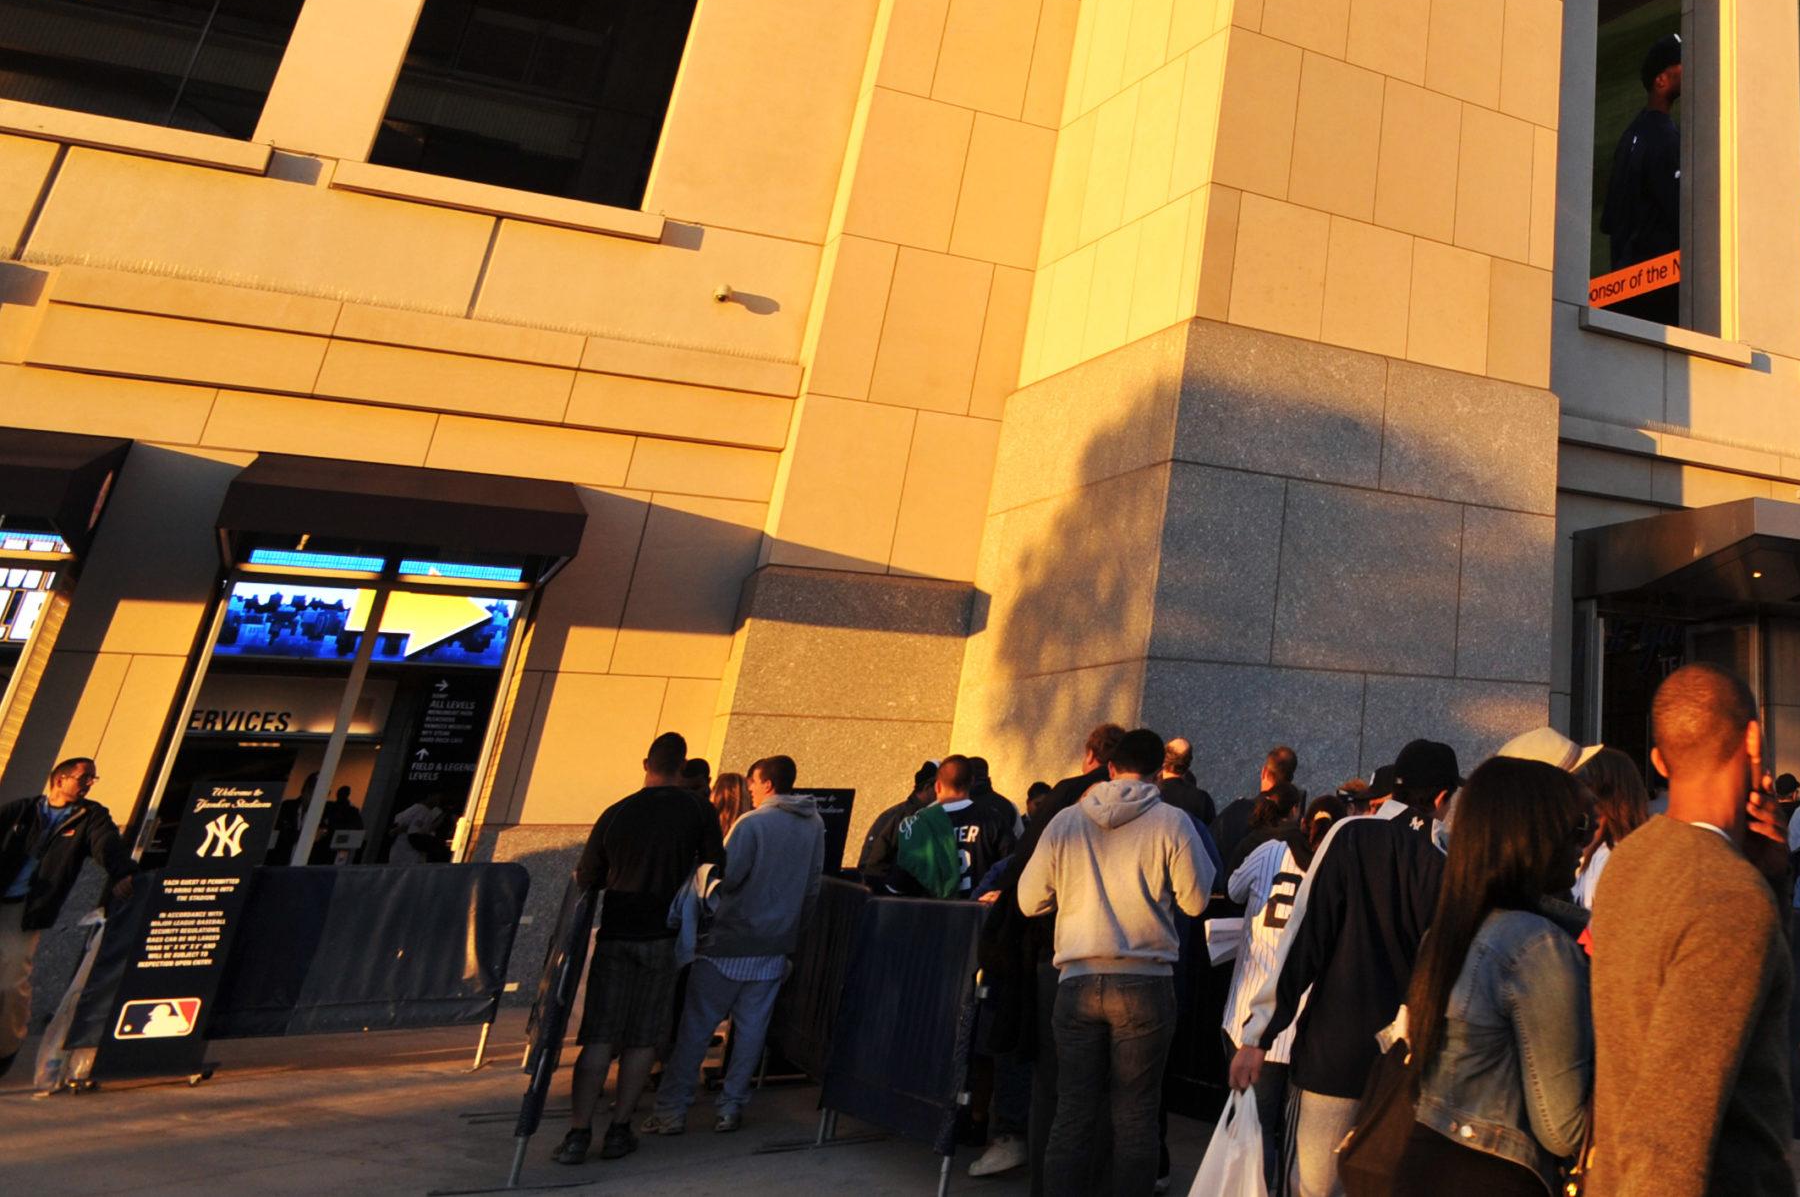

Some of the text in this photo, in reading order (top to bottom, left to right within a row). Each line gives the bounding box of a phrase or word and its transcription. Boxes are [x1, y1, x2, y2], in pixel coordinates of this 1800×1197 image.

[1589, 258, 1681, 302] onsor of the N
[187, 710, 292, 733] ERVICES
[444, 763, 476, 772] LEGEND
[196, 813, 250, 858] NY
[954, 825, 980, 843] TER
